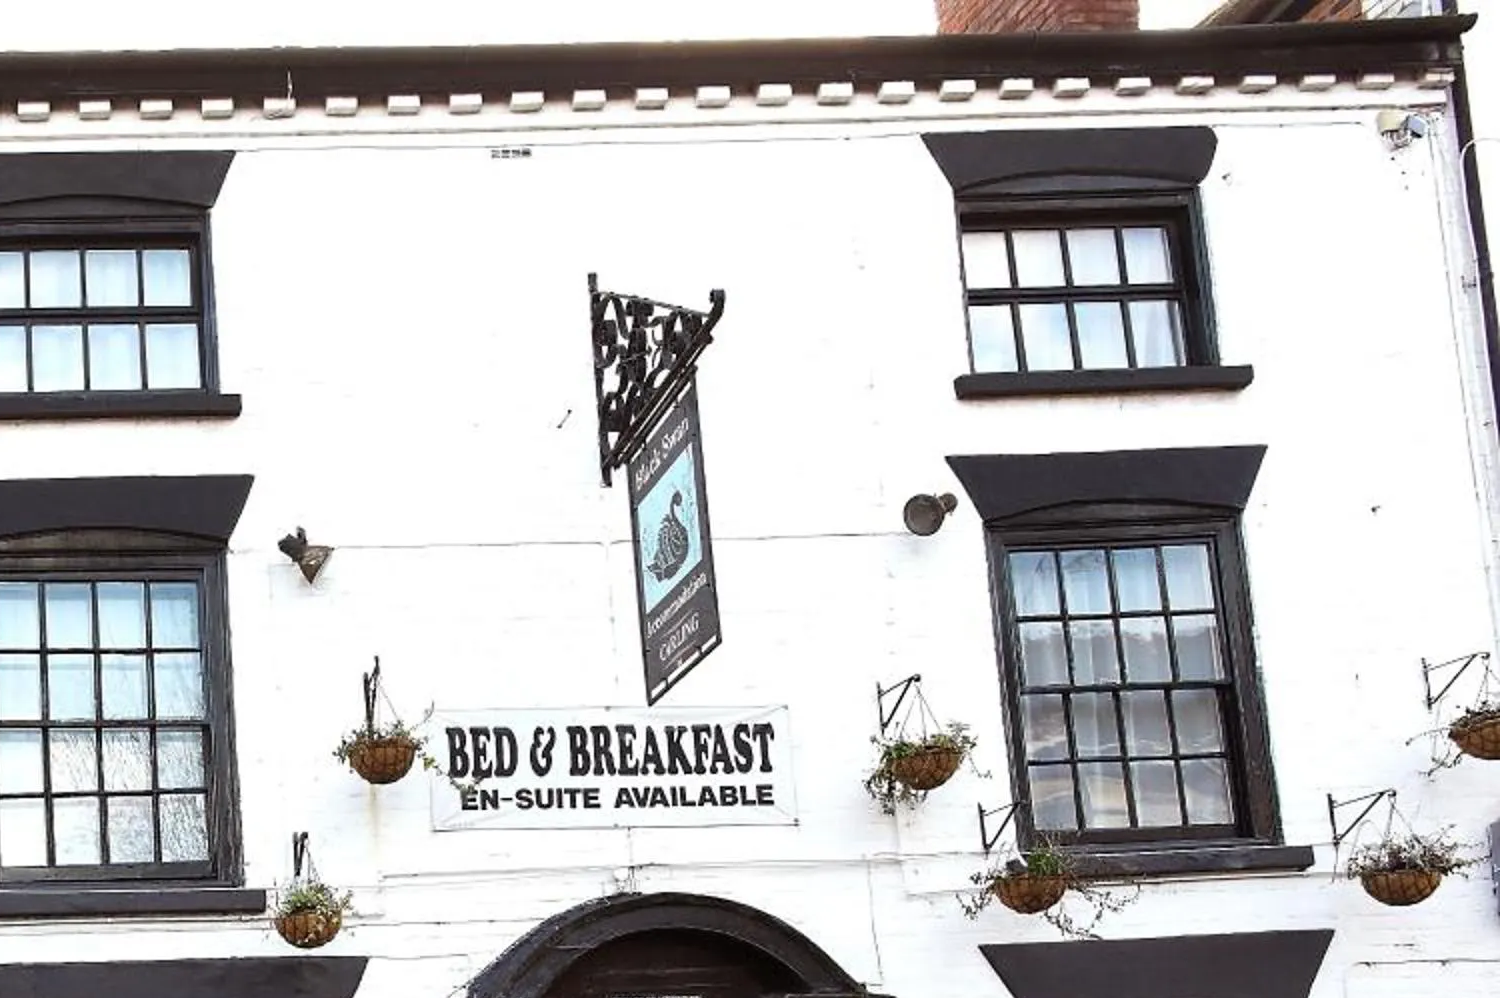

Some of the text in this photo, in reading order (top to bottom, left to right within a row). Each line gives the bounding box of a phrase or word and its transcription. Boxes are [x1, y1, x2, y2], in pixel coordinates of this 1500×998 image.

[660, 612, 699, 661] CARLING
[445, 722, 775, 778] BED & BREAKFAST
[460, 784, 775, 811] EN-SUITE AVAILABLE
